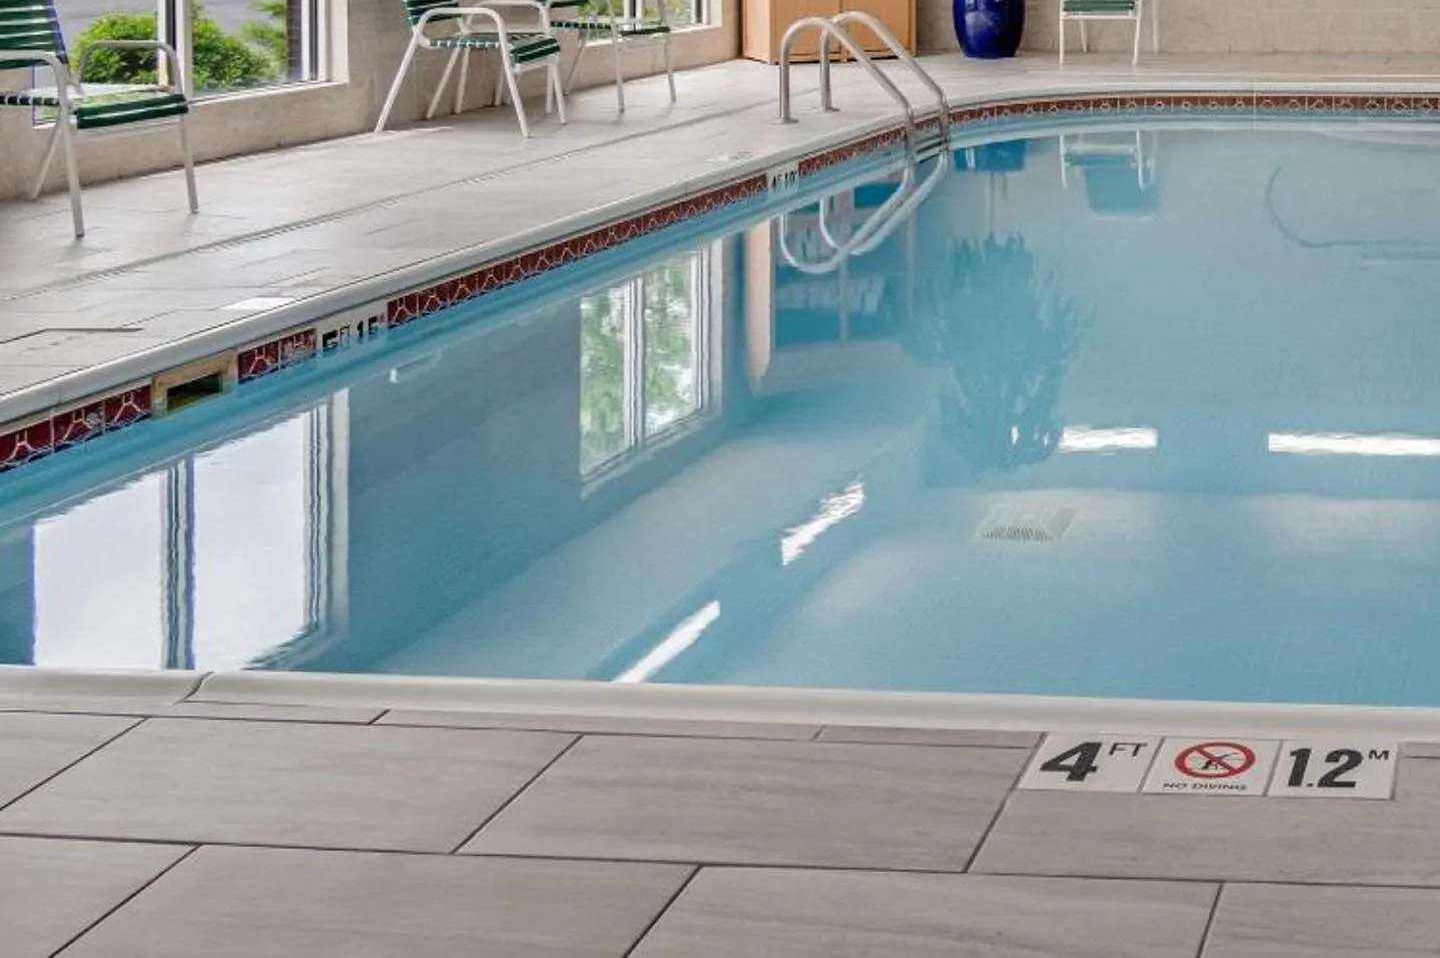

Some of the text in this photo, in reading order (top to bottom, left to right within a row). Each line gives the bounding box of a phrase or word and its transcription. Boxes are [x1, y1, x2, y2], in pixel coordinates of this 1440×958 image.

[1040, 742, 1148, 781] 4 FT
[1288, 748, 1389, 788] 1.2 M
[1192, 782, 1247, 790] DIVING
